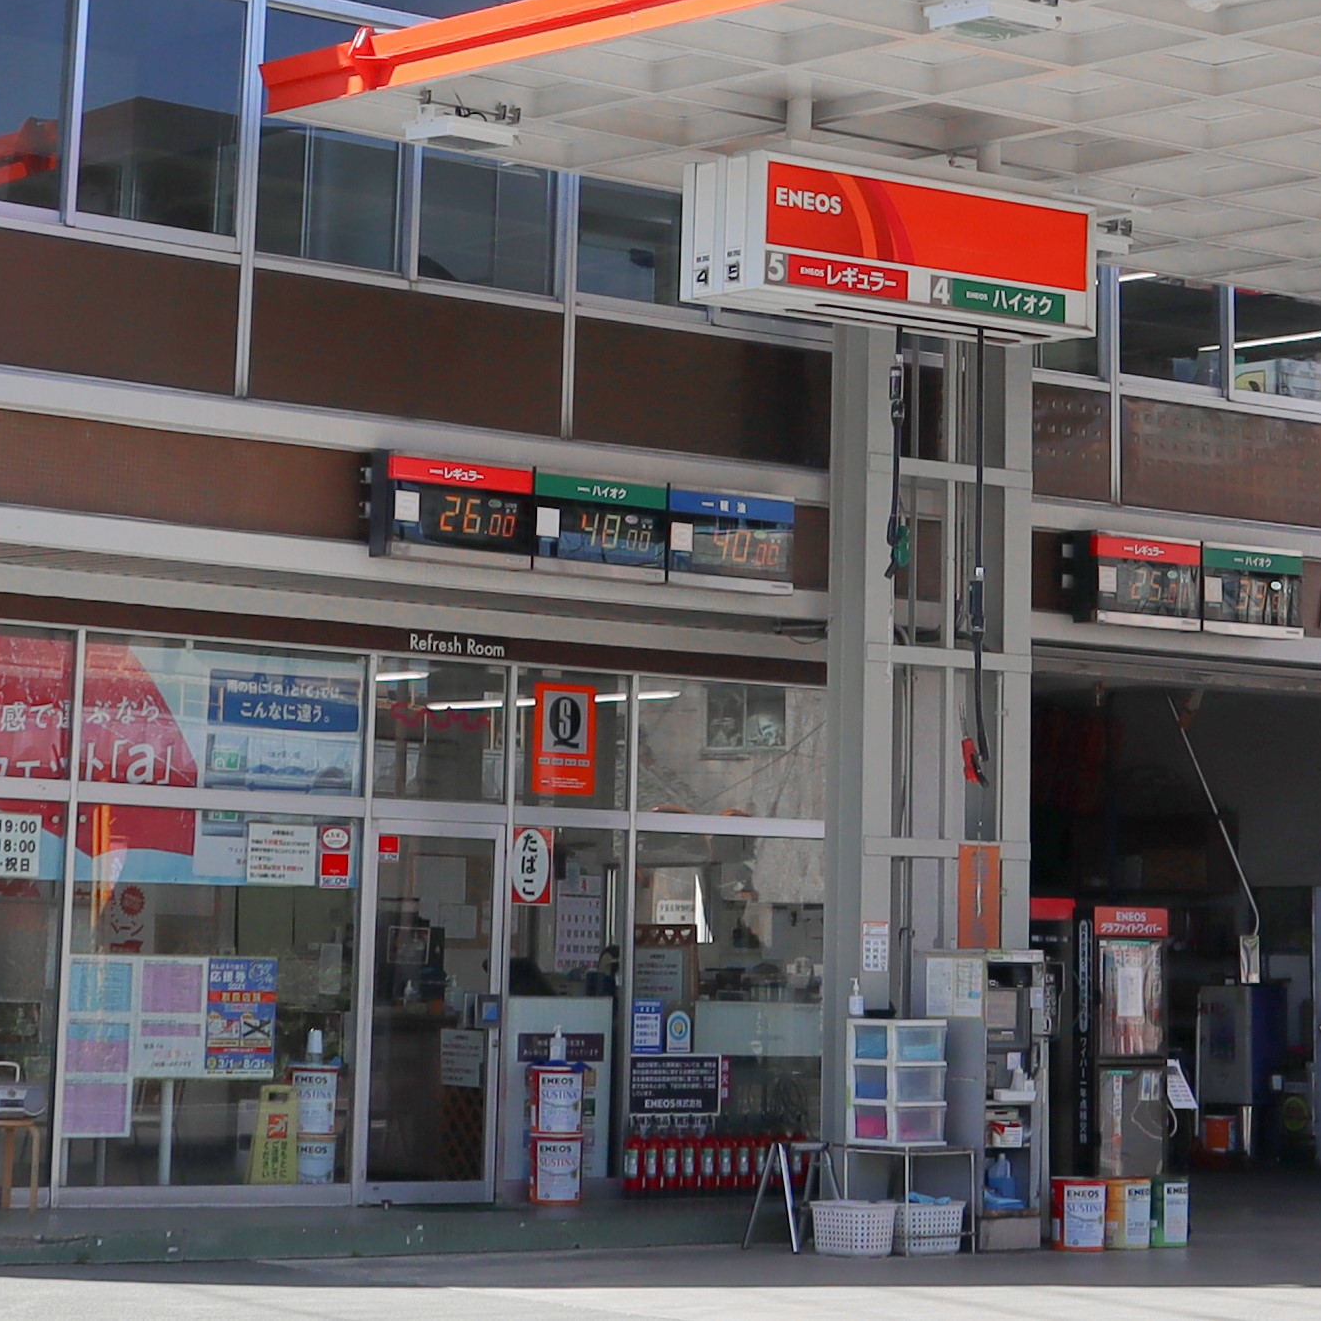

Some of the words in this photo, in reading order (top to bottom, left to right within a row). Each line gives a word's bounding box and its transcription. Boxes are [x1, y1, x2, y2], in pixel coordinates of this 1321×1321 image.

[775, 186, 842, 216] ENEOS
[728, 265, 738, 280] 5
[767, 254, 784, 283] 5
[696, 269, 707, 284] 4
[799, 265, 824, 278] ENEOS
[825, 263, 897, 293] レギュラー
[932, 277, 950, 305] 4
[991, 288, 1053, 316] ハイオク
[444, 466, 484, 483] レギュラー
[591, 483, 628, 500] ハイオク
[1134, 545, 1166, 558] レギュラー
[1244, 555, 1272, 568] ハイオク
[410, 632, 462, 654] Refresh
[467, 638, 505, 658] Room
[240, 701, 331, 724] こんなに違う。
[520, 832, 538, 898] たばこ
[1116, 911, 1147, 922] ENEOS
[1100, 923, 1163, 934] グラファイトワイパー
[294, 1075, 328, 1084] ENEOS
[541, 1077, 574, 1085] ENEOS
[298, 1090, 333, 1099] USTINA
[541, 1089, 578, 1100] SUSTINA
[644, 1098, 703, 1109] ENEOS株式会社
[299, 1145, 328, 1154] NEOS
[539, 1145, 572, 1153] ENEOS
[539, 1157, 576, 1168] SUSTINA
[1066, 1189, 1100, 1198] ENEOS
[1127, 1188, 1150, 1197] ENEO
